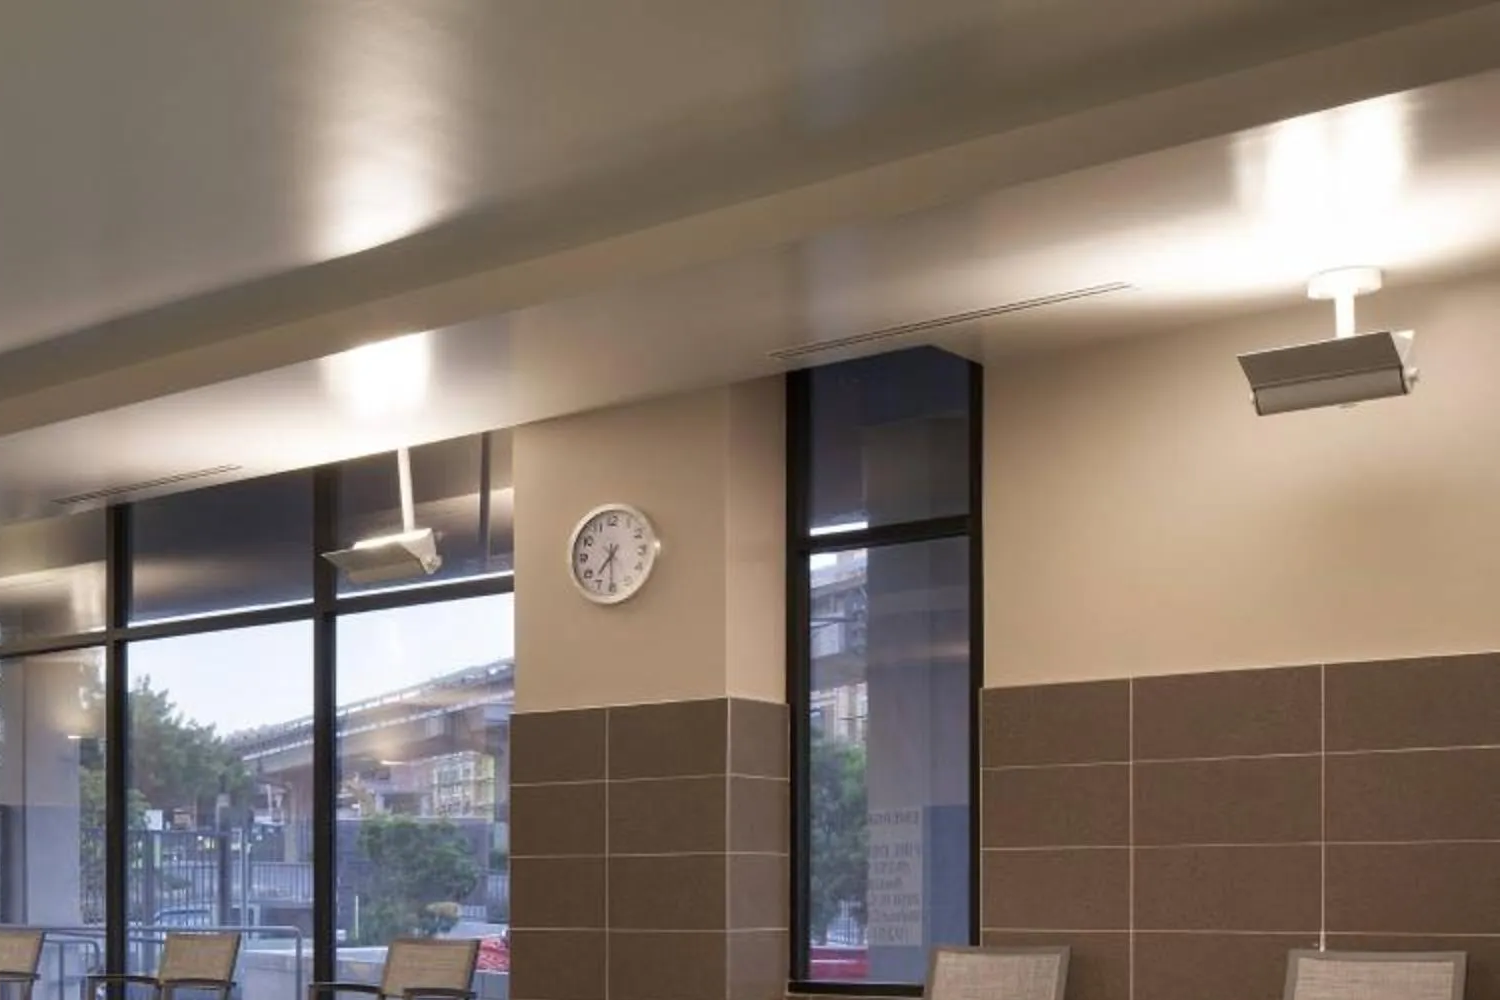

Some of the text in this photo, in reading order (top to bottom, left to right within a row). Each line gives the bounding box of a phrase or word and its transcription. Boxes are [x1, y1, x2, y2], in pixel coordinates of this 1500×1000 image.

[607, 515, 619, 527] 12
[634, 527, 643, 539] 2
[583, 535, 594, 548] 10
[595, 579, 603, 591] 7
